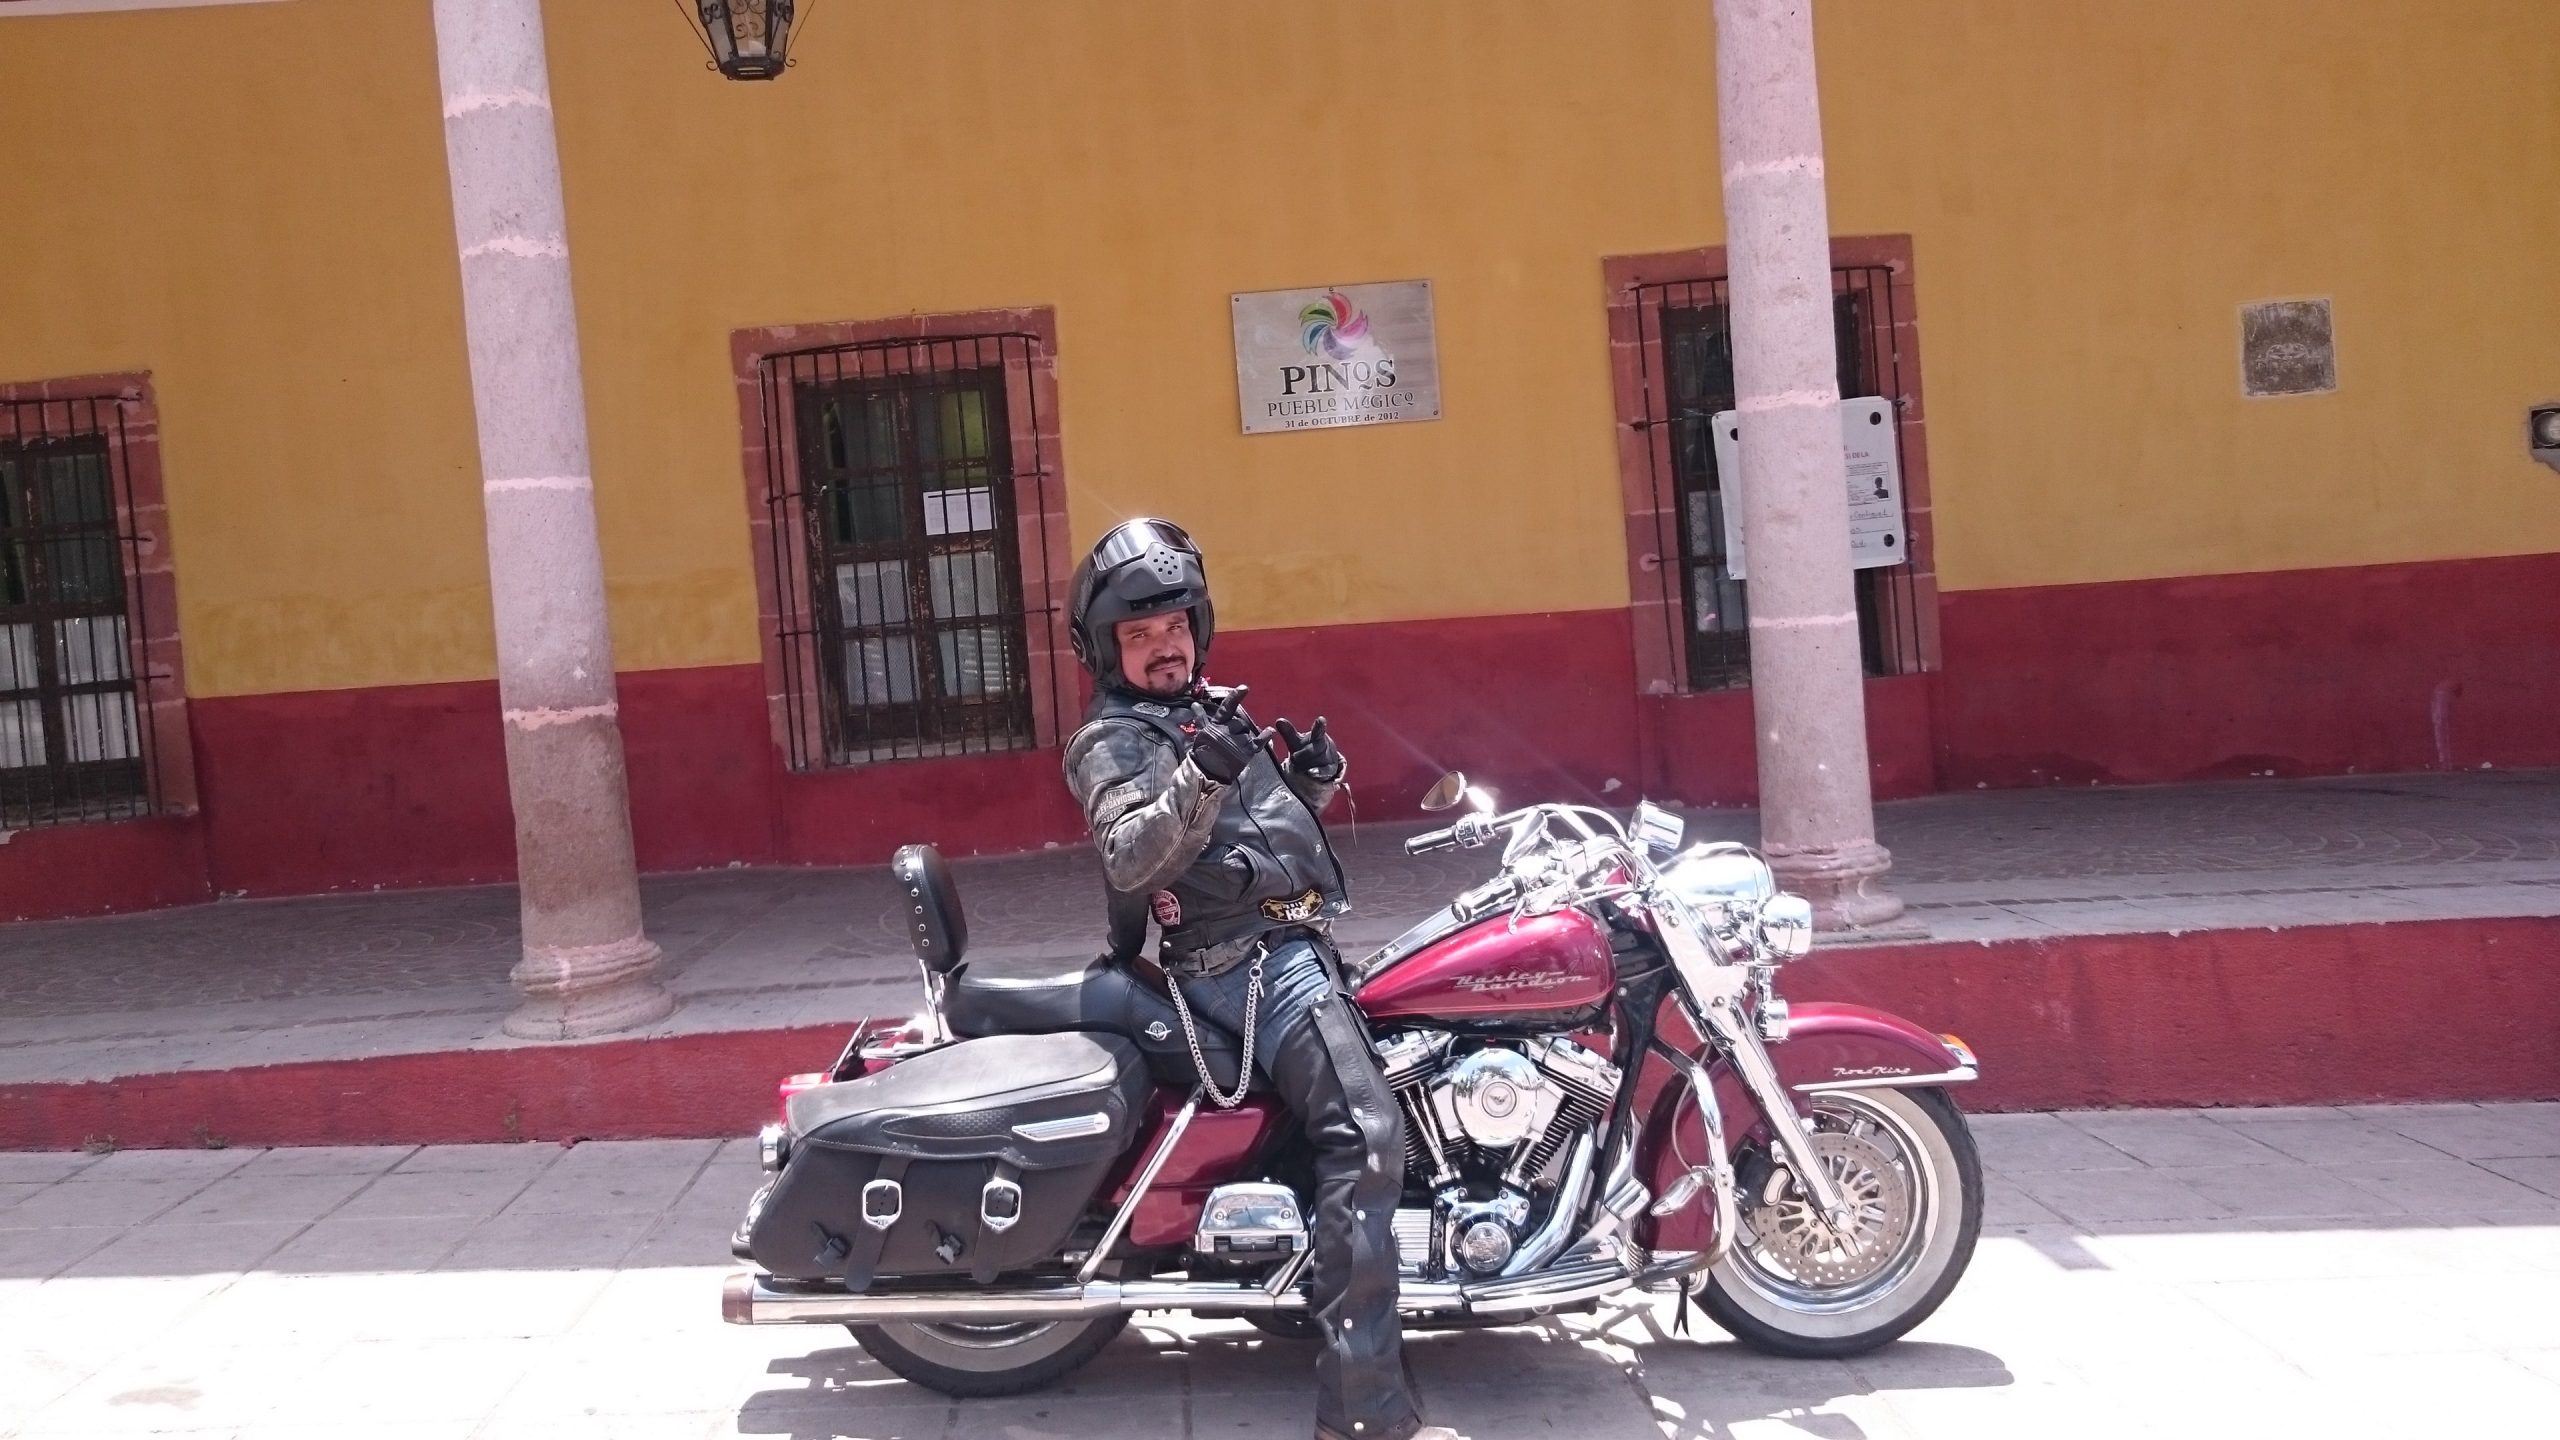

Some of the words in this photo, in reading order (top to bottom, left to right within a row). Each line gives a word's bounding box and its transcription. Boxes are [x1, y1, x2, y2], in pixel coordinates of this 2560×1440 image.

[1279, 359, 1396, 395] PINOS
[1267, 399, 1337, 417] PUEBLO
[1285, 420, 1295, 429] 31
[1298, 419, 1309, 427] de
[1311, 415, 1361, 426] OCTUBRE
[1364, 413, 1376, 422] de
[1450, 971, 1564, 987] Harley
[1471, 975, 1591, 992] Davidson
